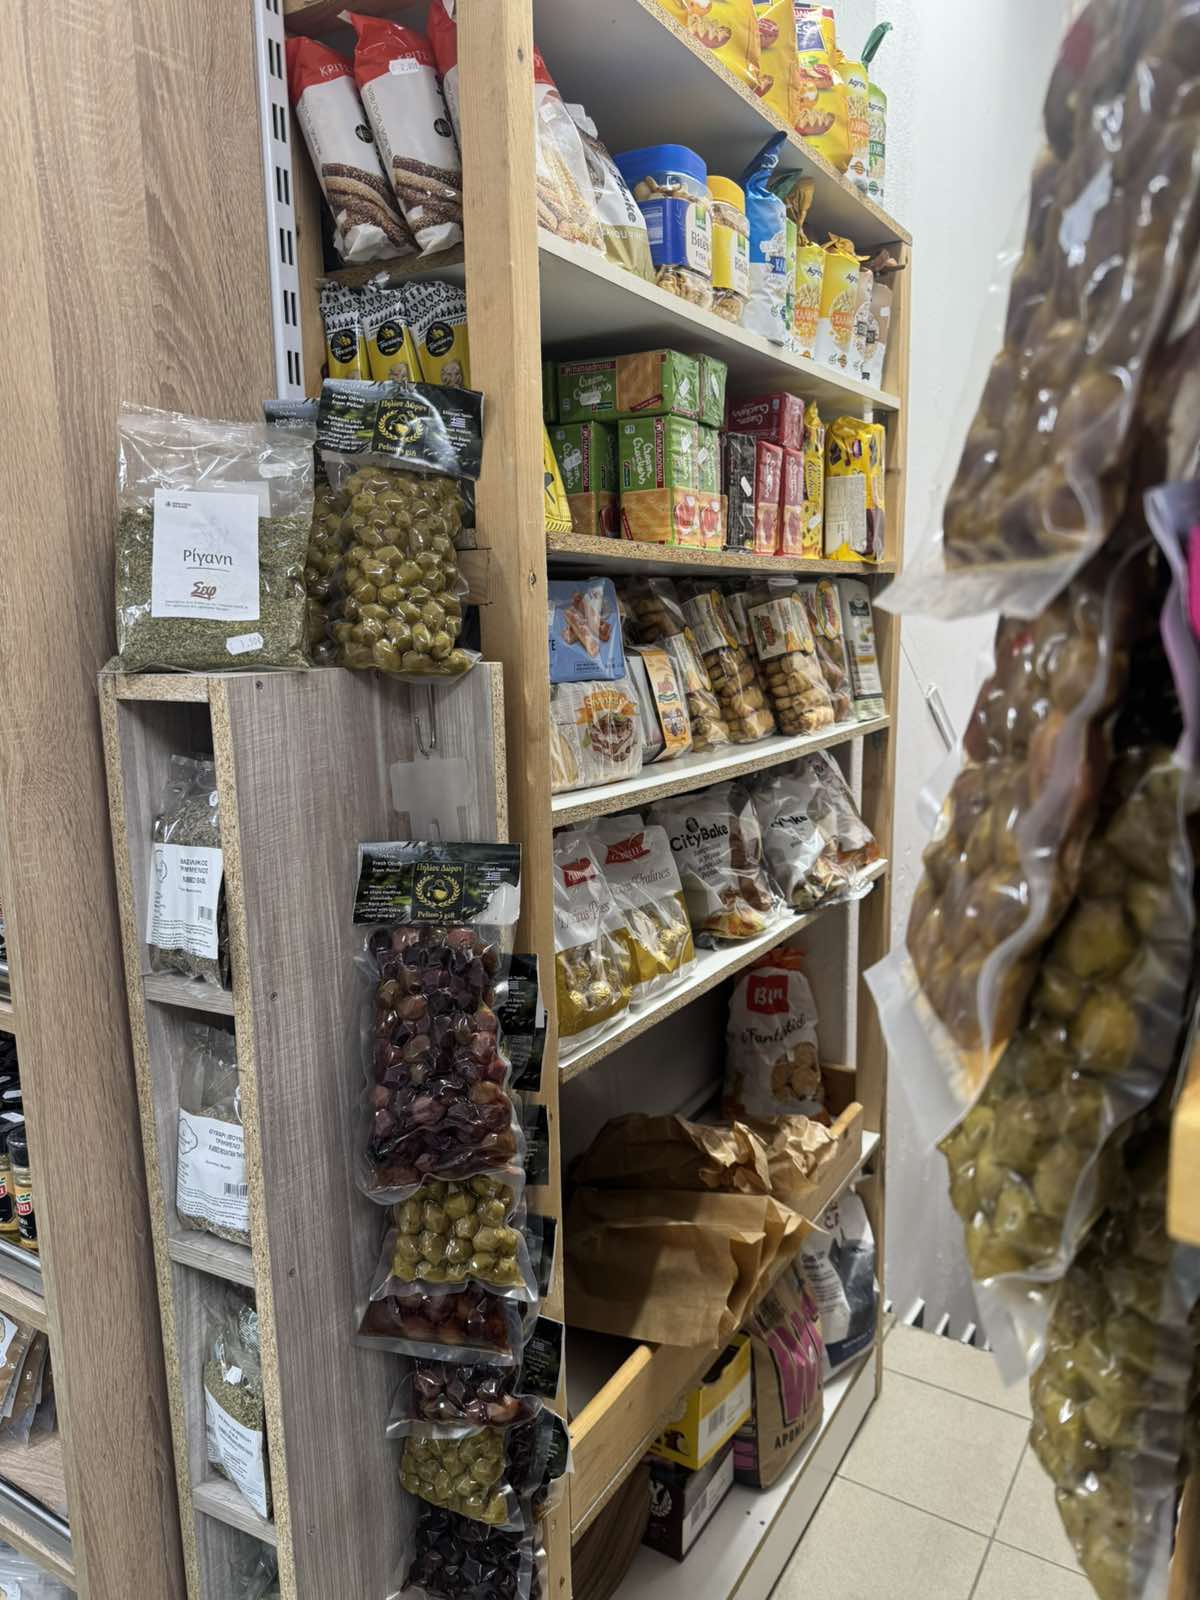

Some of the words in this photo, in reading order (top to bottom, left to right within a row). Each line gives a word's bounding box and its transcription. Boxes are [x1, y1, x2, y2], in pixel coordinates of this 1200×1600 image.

[633, 437, 646, 485] Crackers
[643, 443, 653, 479] Cream
[183, 548, 233, 567] Ρίγανη
[191, 581, 217, 600] Σεφ
[670, 822, 729, 852] CityBake
